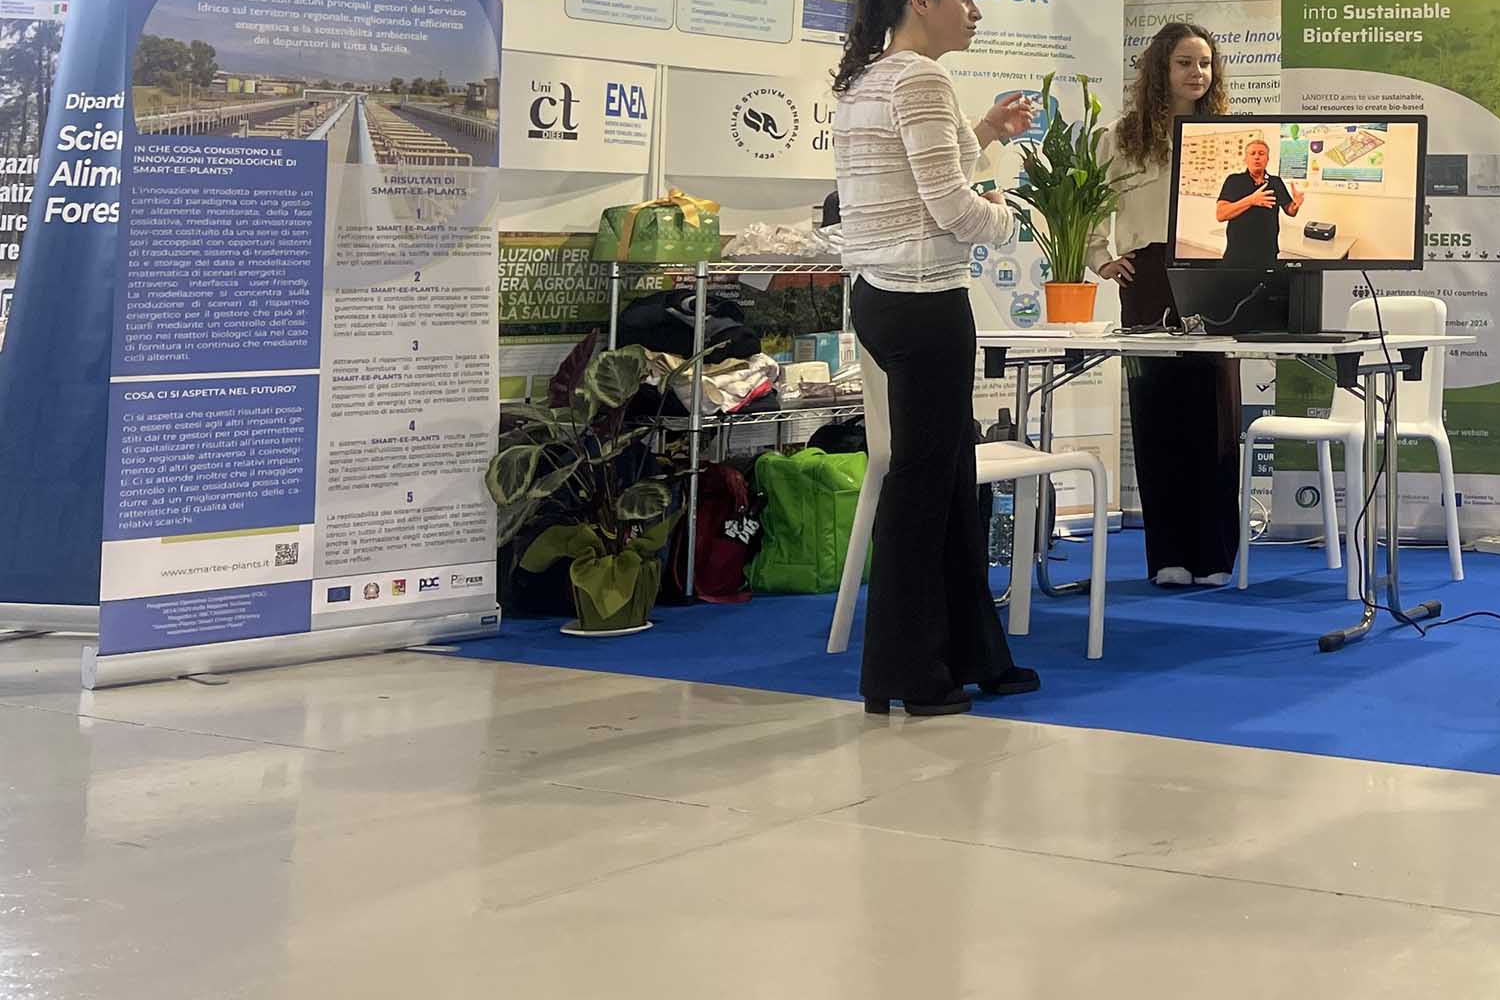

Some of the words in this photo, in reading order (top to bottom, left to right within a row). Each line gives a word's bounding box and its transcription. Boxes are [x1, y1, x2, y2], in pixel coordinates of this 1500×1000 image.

[1303, 5, 1337, 20] into
[1343, 3, 1450, 19] Sustainable
[1303, 28, 1423, 43] Biofertilisers
[531, 80, 551, 93] Uni
[66, 92, 124, 112] Diparti
[529, 81, 580, 130] ct
[605, 82, 648, 120] ENEA
[204, 147, 268, 155] CONSISTONO
[134, 156, 204, 164] INNOVAZIONI
[207, 157, 283, 165] TECNOLOGICHE
[134, 166, 232, 174] SMART-EE-PLANTS?
[371, 188, 466, 196] SMART-EE-PLANTS
[44, 197, 119, 223] Fores
[417, 209, 421, 219] 1
[414, 272, 420, 281] 2
[499, 307, 518, 320] LA
[522, 305, 578, 319] SALUTE
[413, 341, 418, 350] 3
[124, 391, 154, 399] COSA
[181, 388, 226, 397] ASPETTA
[229, 387, 248, 395] NEL
[251, 385, 296, 394] FUTURO?
[409, 421, 415, 431] 4
[407, 492, 413, 502] 5
[161, 560, 269, 577] www.smartee-plants.it
